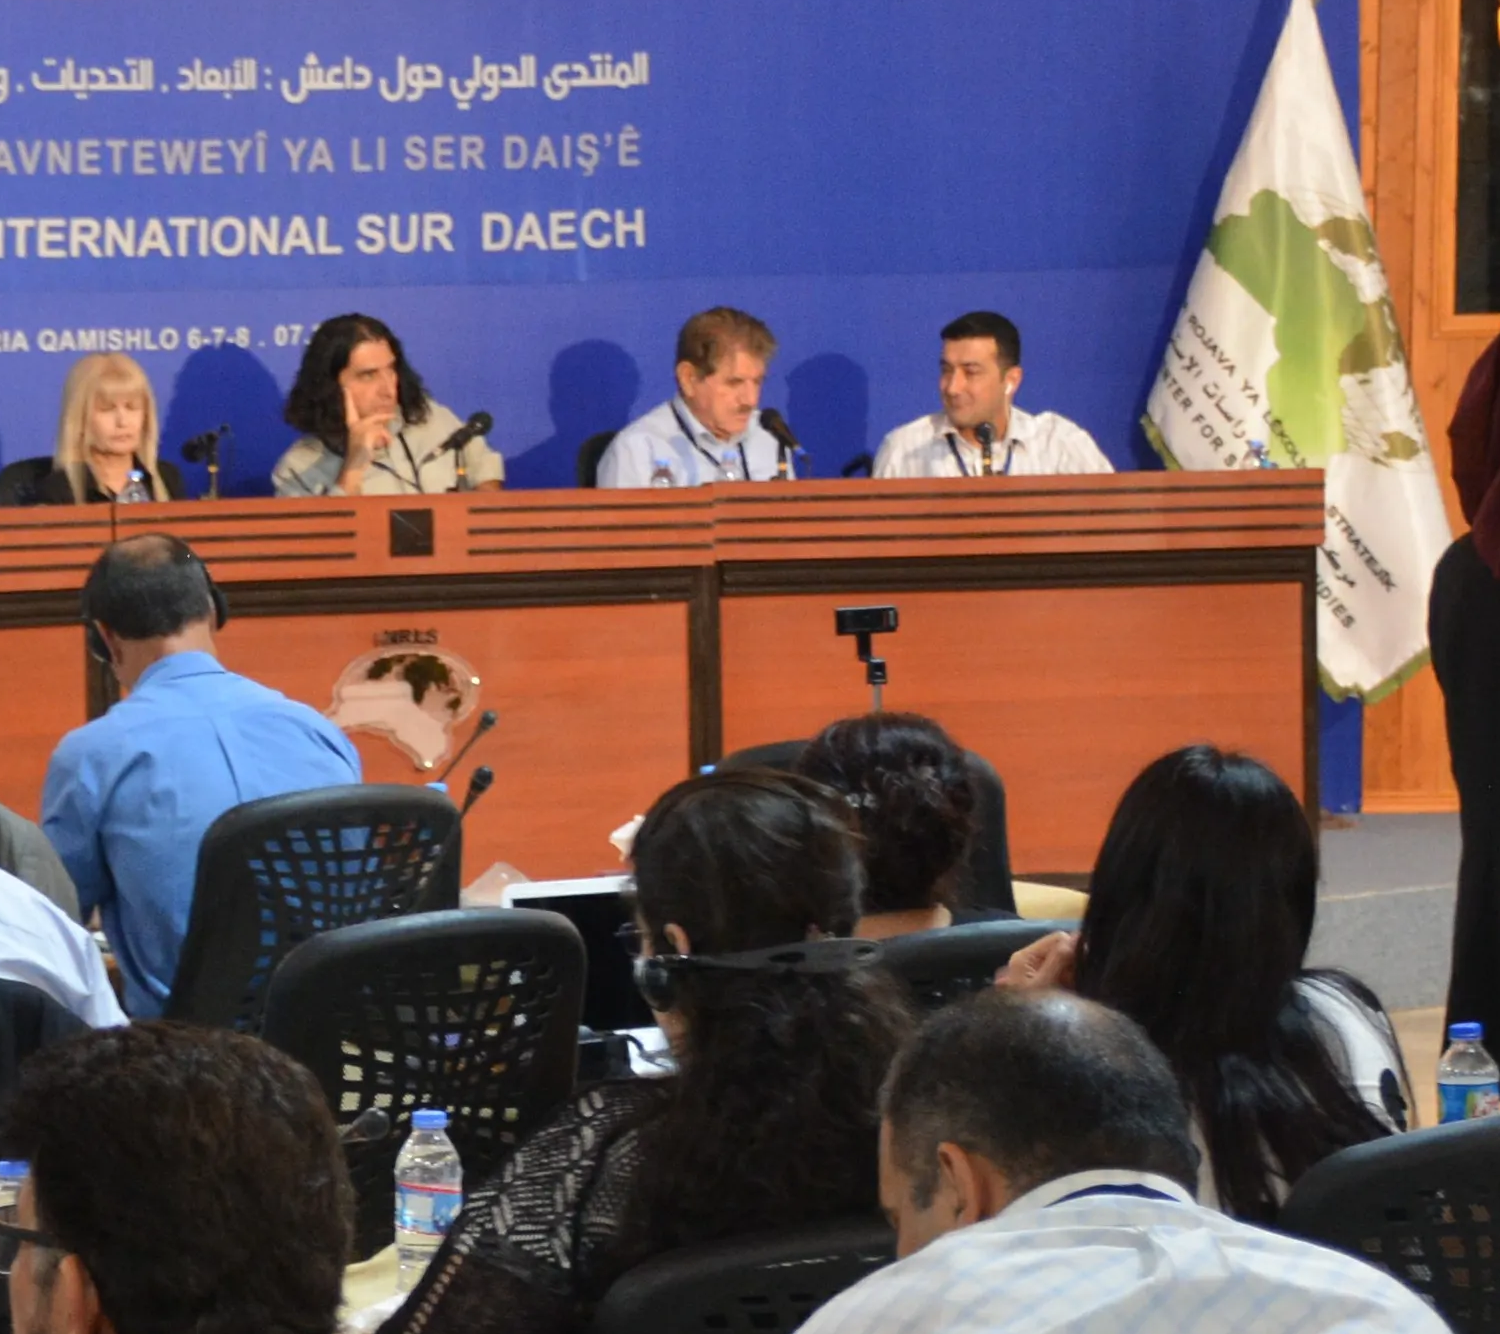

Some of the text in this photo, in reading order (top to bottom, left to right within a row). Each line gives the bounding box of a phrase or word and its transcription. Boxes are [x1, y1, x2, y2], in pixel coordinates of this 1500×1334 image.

[31, 57, 155, 101] التحديات
[280, 51, 373, 105] داعش
[380, 56, 443, 103] حول
[449, 54, 537, 111] الدولي
[543, 52, 650, 100] المنتدى
[282, 138, 335, 173] YA
[350, 137, 388, 172] LI
[404, 134, 487, 170] SER
[355, 212, 455, 255] SUR
[480, 207, 647, 254] DAECH
[36, 325, 179, 355] QAMISHLO
[186, 325, 251, 349] 6-7-8
[1187, 314, 1236, 378] ROJAVA
[1240, 377, 1260, 408] YA
[1192, 413, 1225, 452] FOR
